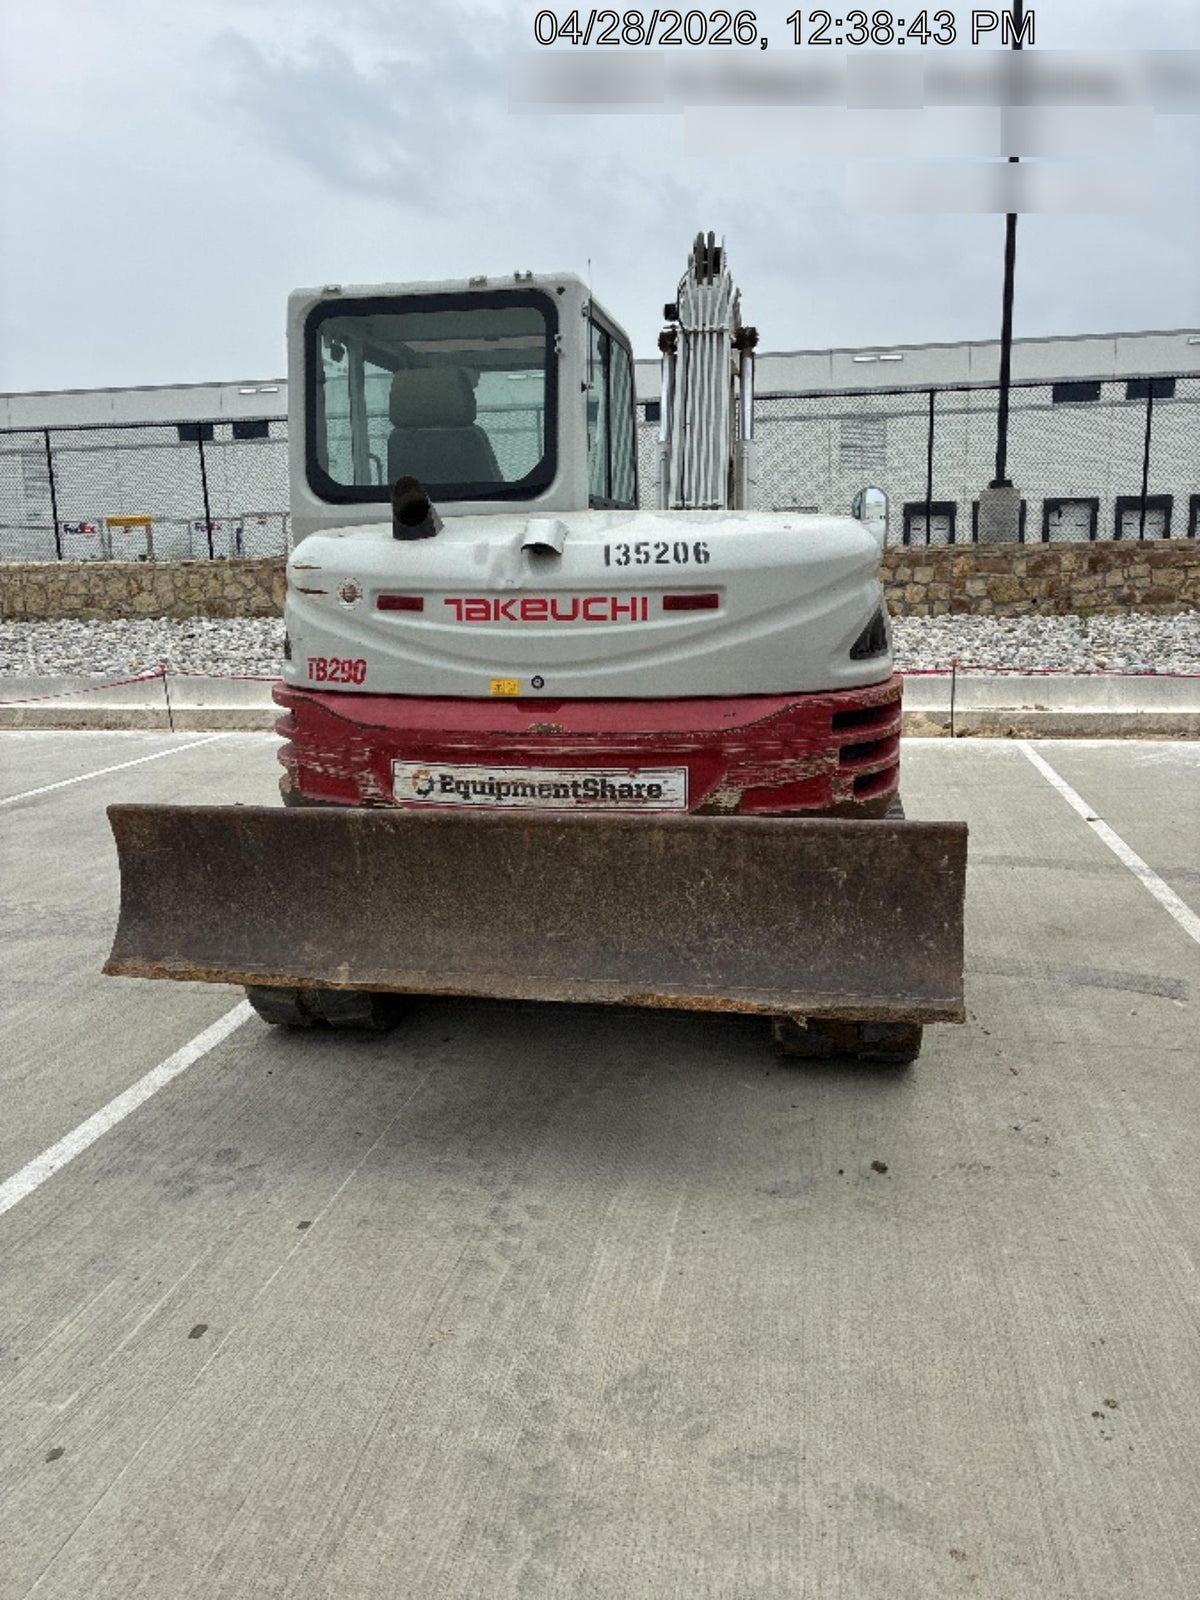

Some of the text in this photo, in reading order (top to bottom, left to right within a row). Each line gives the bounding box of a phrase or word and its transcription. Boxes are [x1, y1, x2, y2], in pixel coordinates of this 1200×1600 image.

[603, 541, 710, 567] 135206
[444, 596, 648, 622] TAKEUCHI
[307, 656, 367, 685] TB290
[438, 773, 663, 801] EquipmentShare
